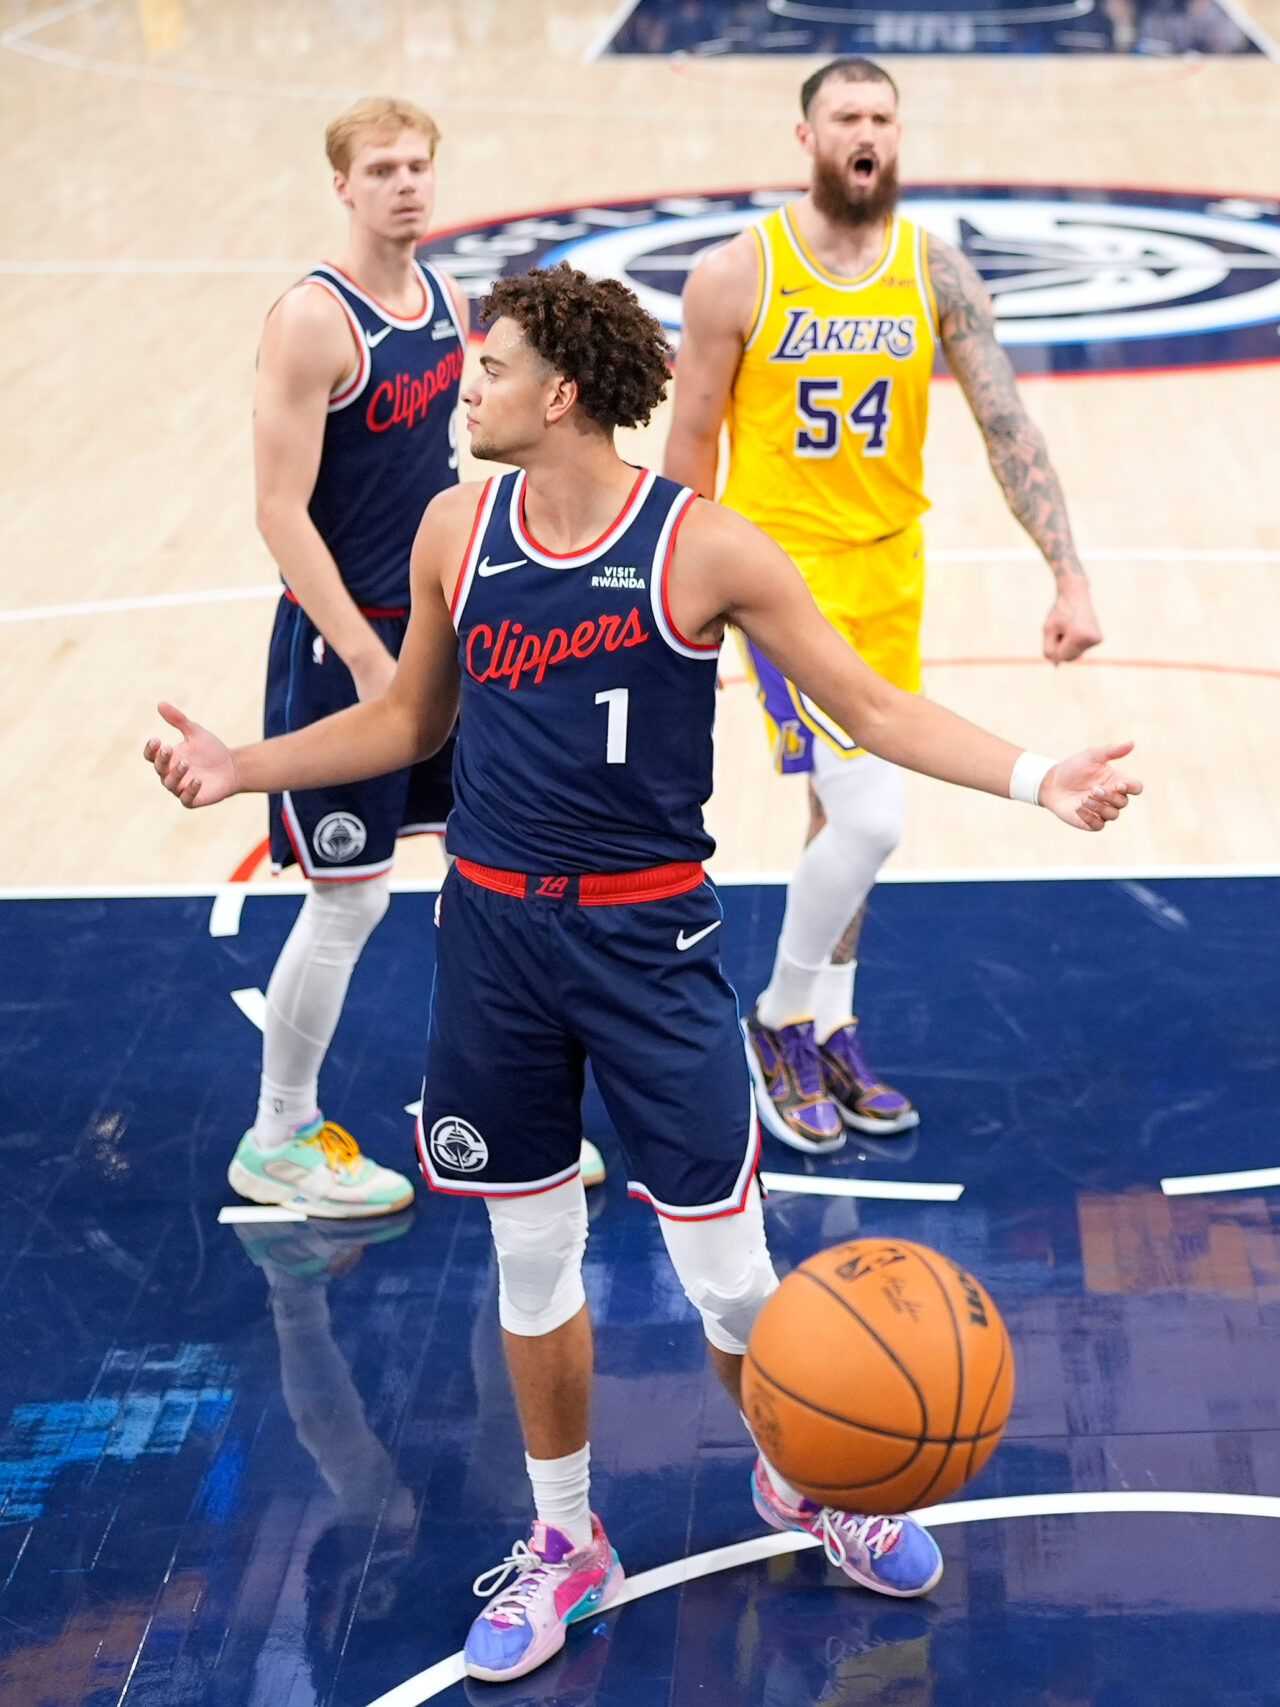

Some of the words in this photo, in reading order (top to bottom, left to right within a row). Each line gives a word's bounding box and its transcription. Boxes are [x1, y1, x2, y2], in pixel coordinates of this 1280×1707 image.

[768, 306, 917, 363] LAKERS
[793, 376, 895, 459] 54
[591, 576, 646, 589] RWANDA
[604, 566, 636, 578] VISIT
[466, 607, 650, 690] Clippers
[594, 687, 629, 764] 1
